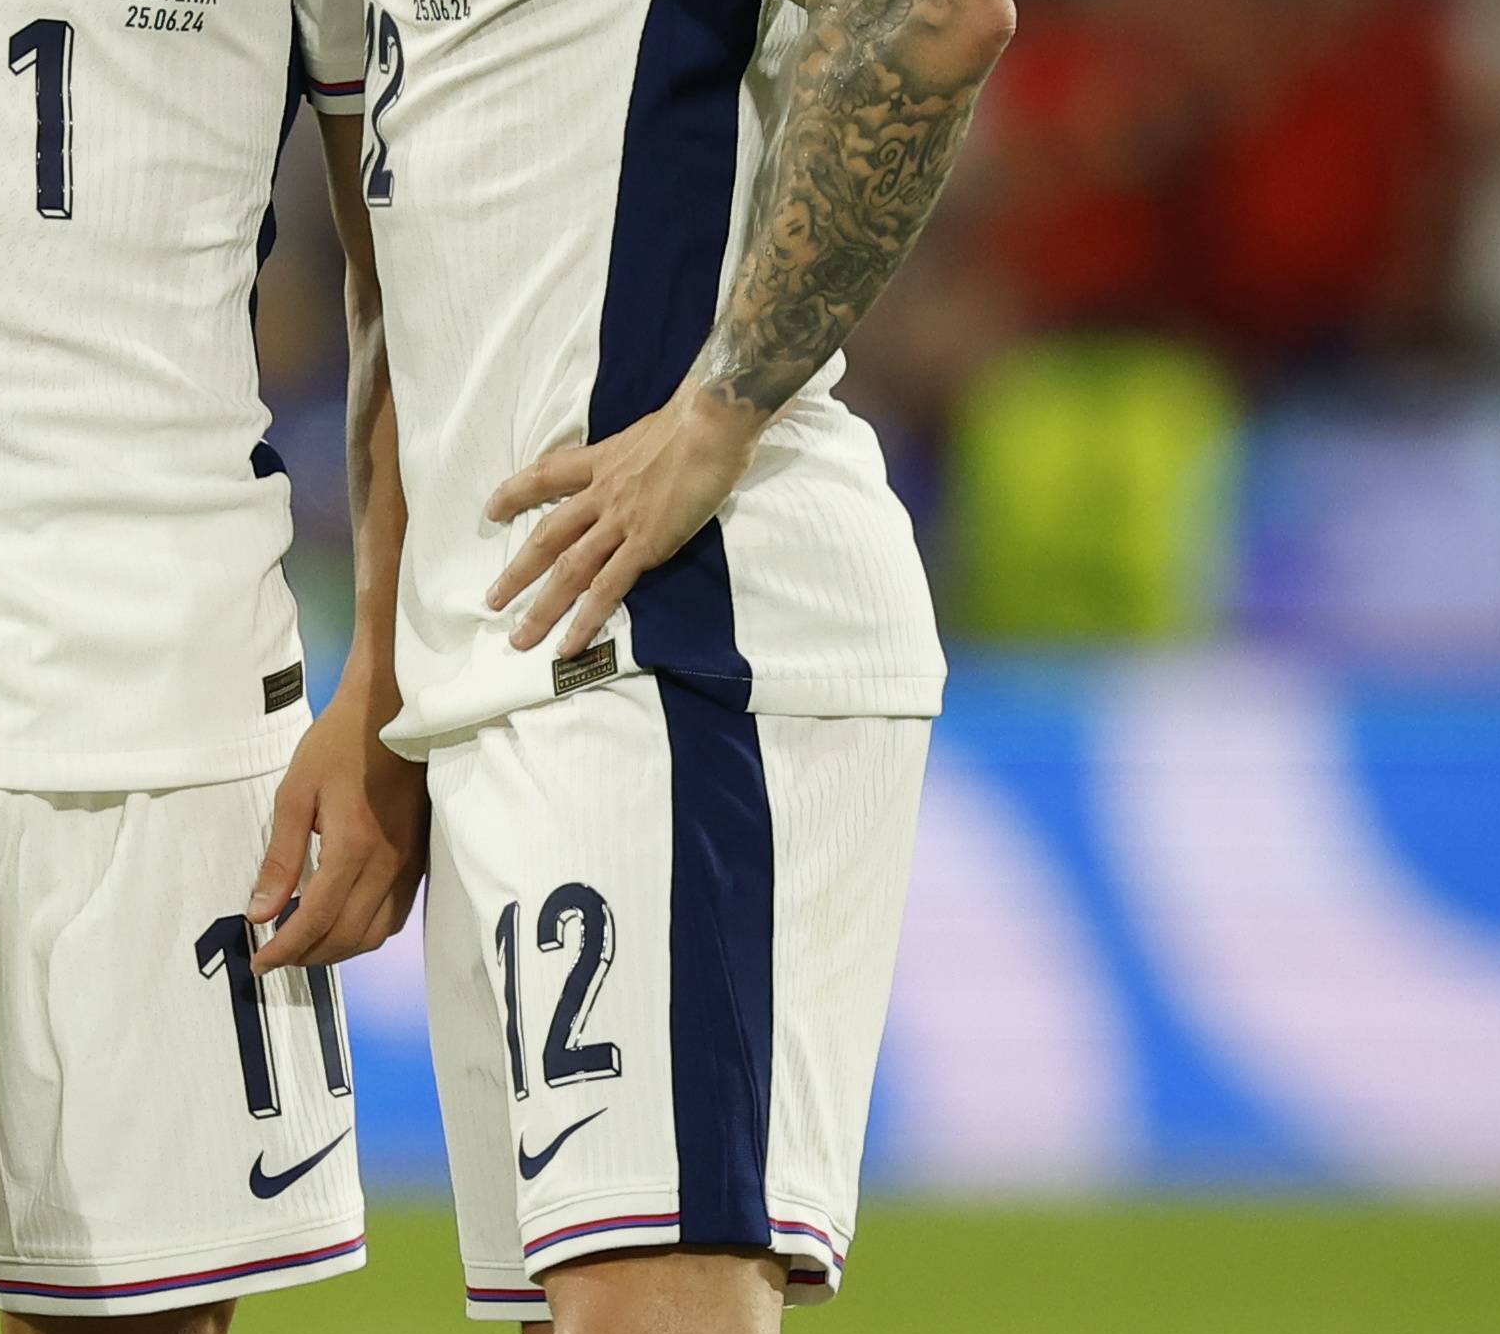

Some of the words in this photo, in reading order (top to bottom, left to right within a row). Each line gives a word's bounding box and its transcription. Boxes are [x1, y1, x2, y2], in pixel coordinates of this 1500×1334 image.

[124, 4, 205, 33] 25.06.24
[194, 895, 352, 1120] 11
[496, 881, 623, 1102] 12
